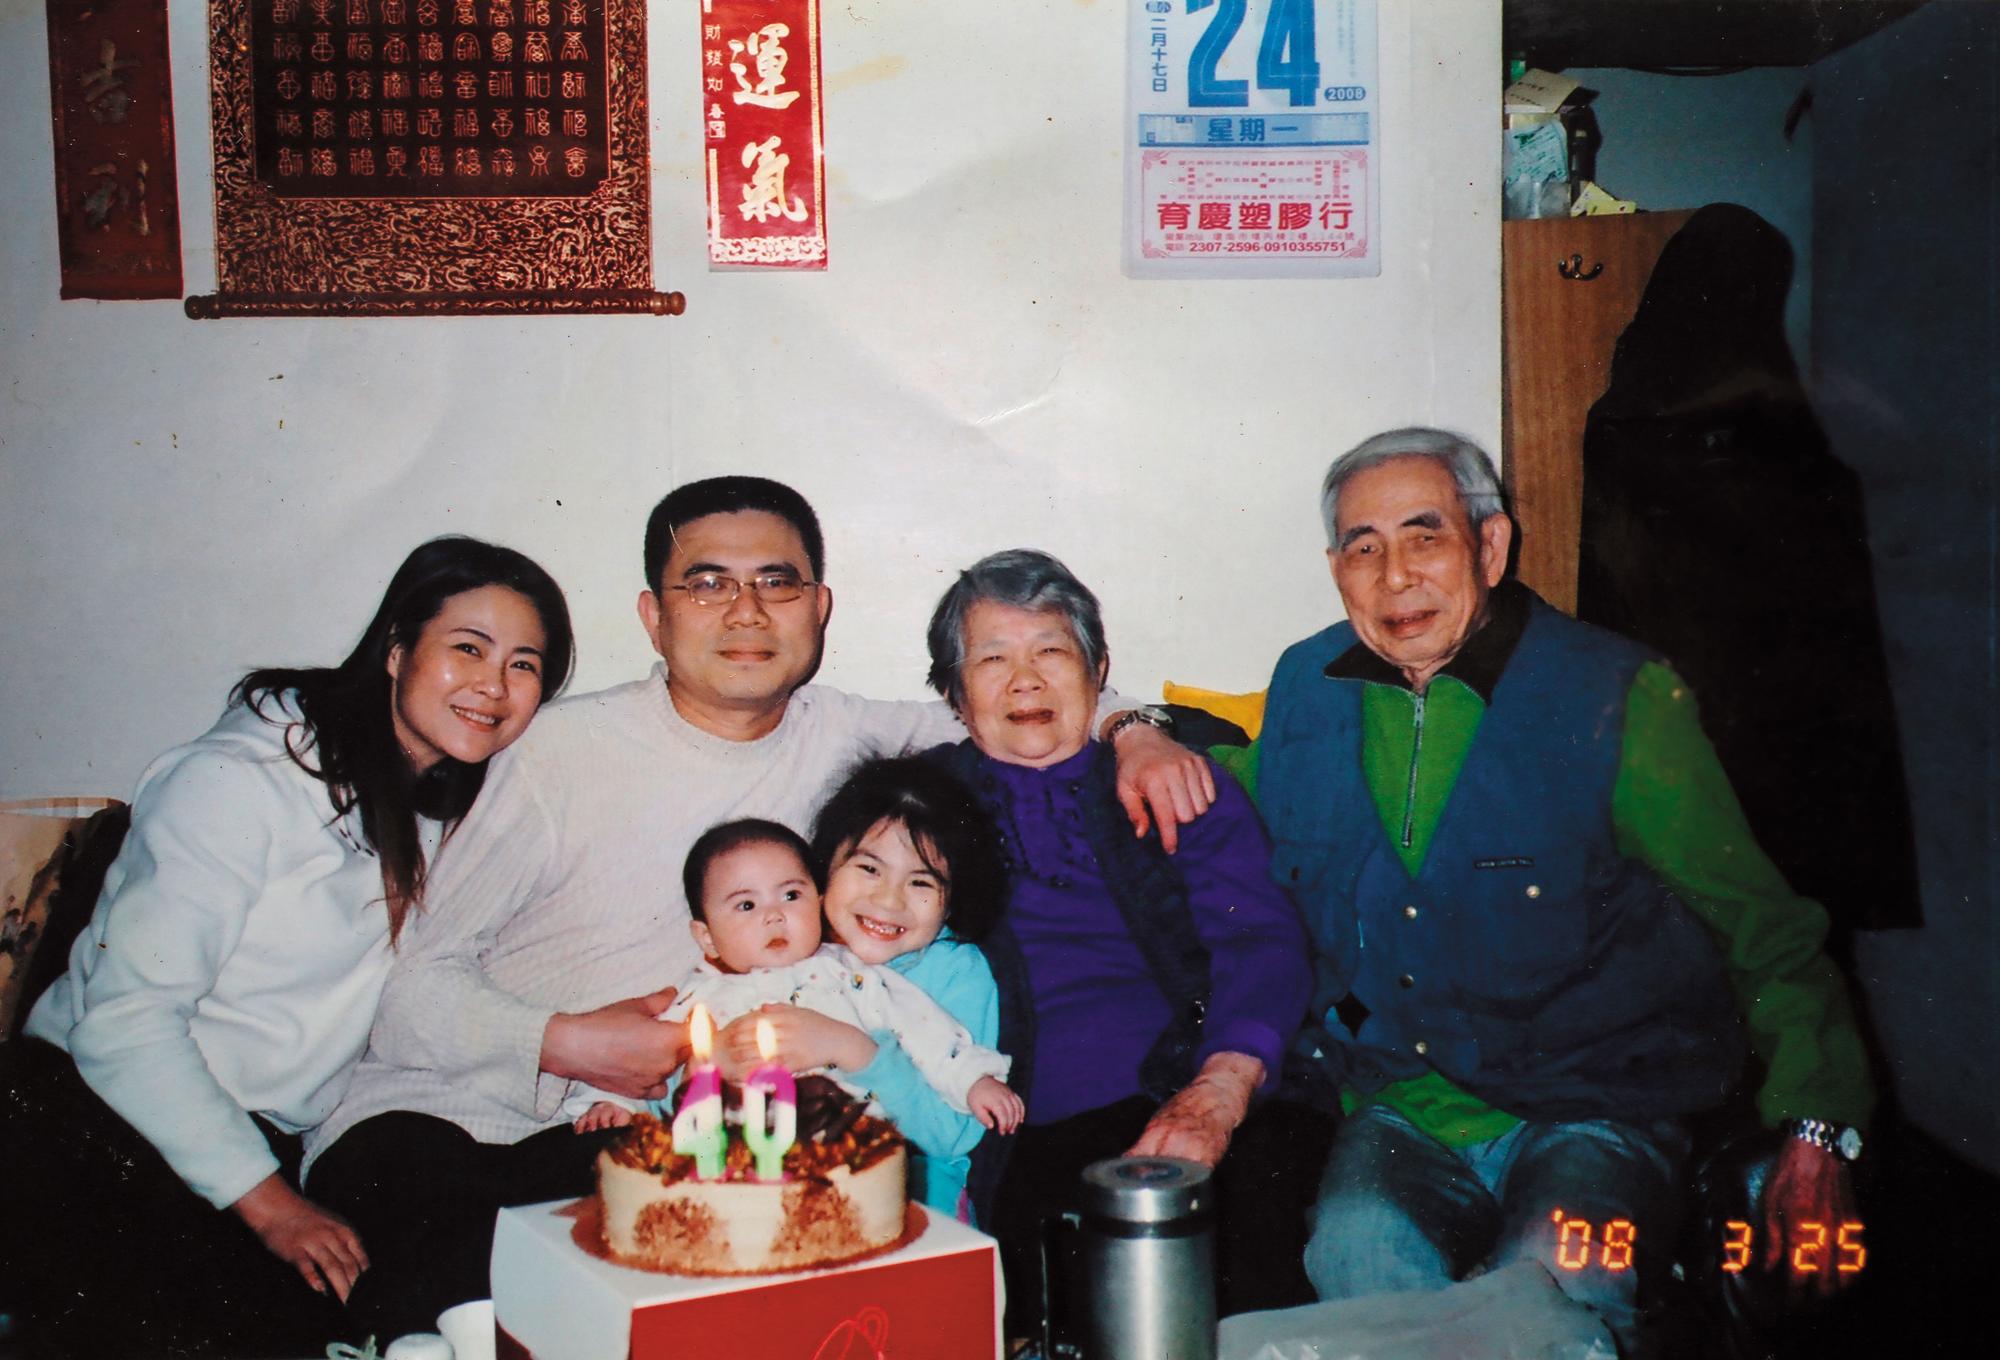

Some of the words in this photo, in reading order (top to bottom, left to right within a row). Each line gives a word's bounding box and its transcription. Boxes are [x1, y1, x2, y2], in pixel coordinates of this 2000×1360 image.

[1150, 18, 1168, 92] 二月十七日
[1186, 0, 1320, 107] 24
[1328, 88, 1363, 100] 2008
[728, 22, 809, 223] 運氣
[1207, 117, 1299, 142] 星期一
[1157, 201, 1354, 231] 育慶塑膠行
